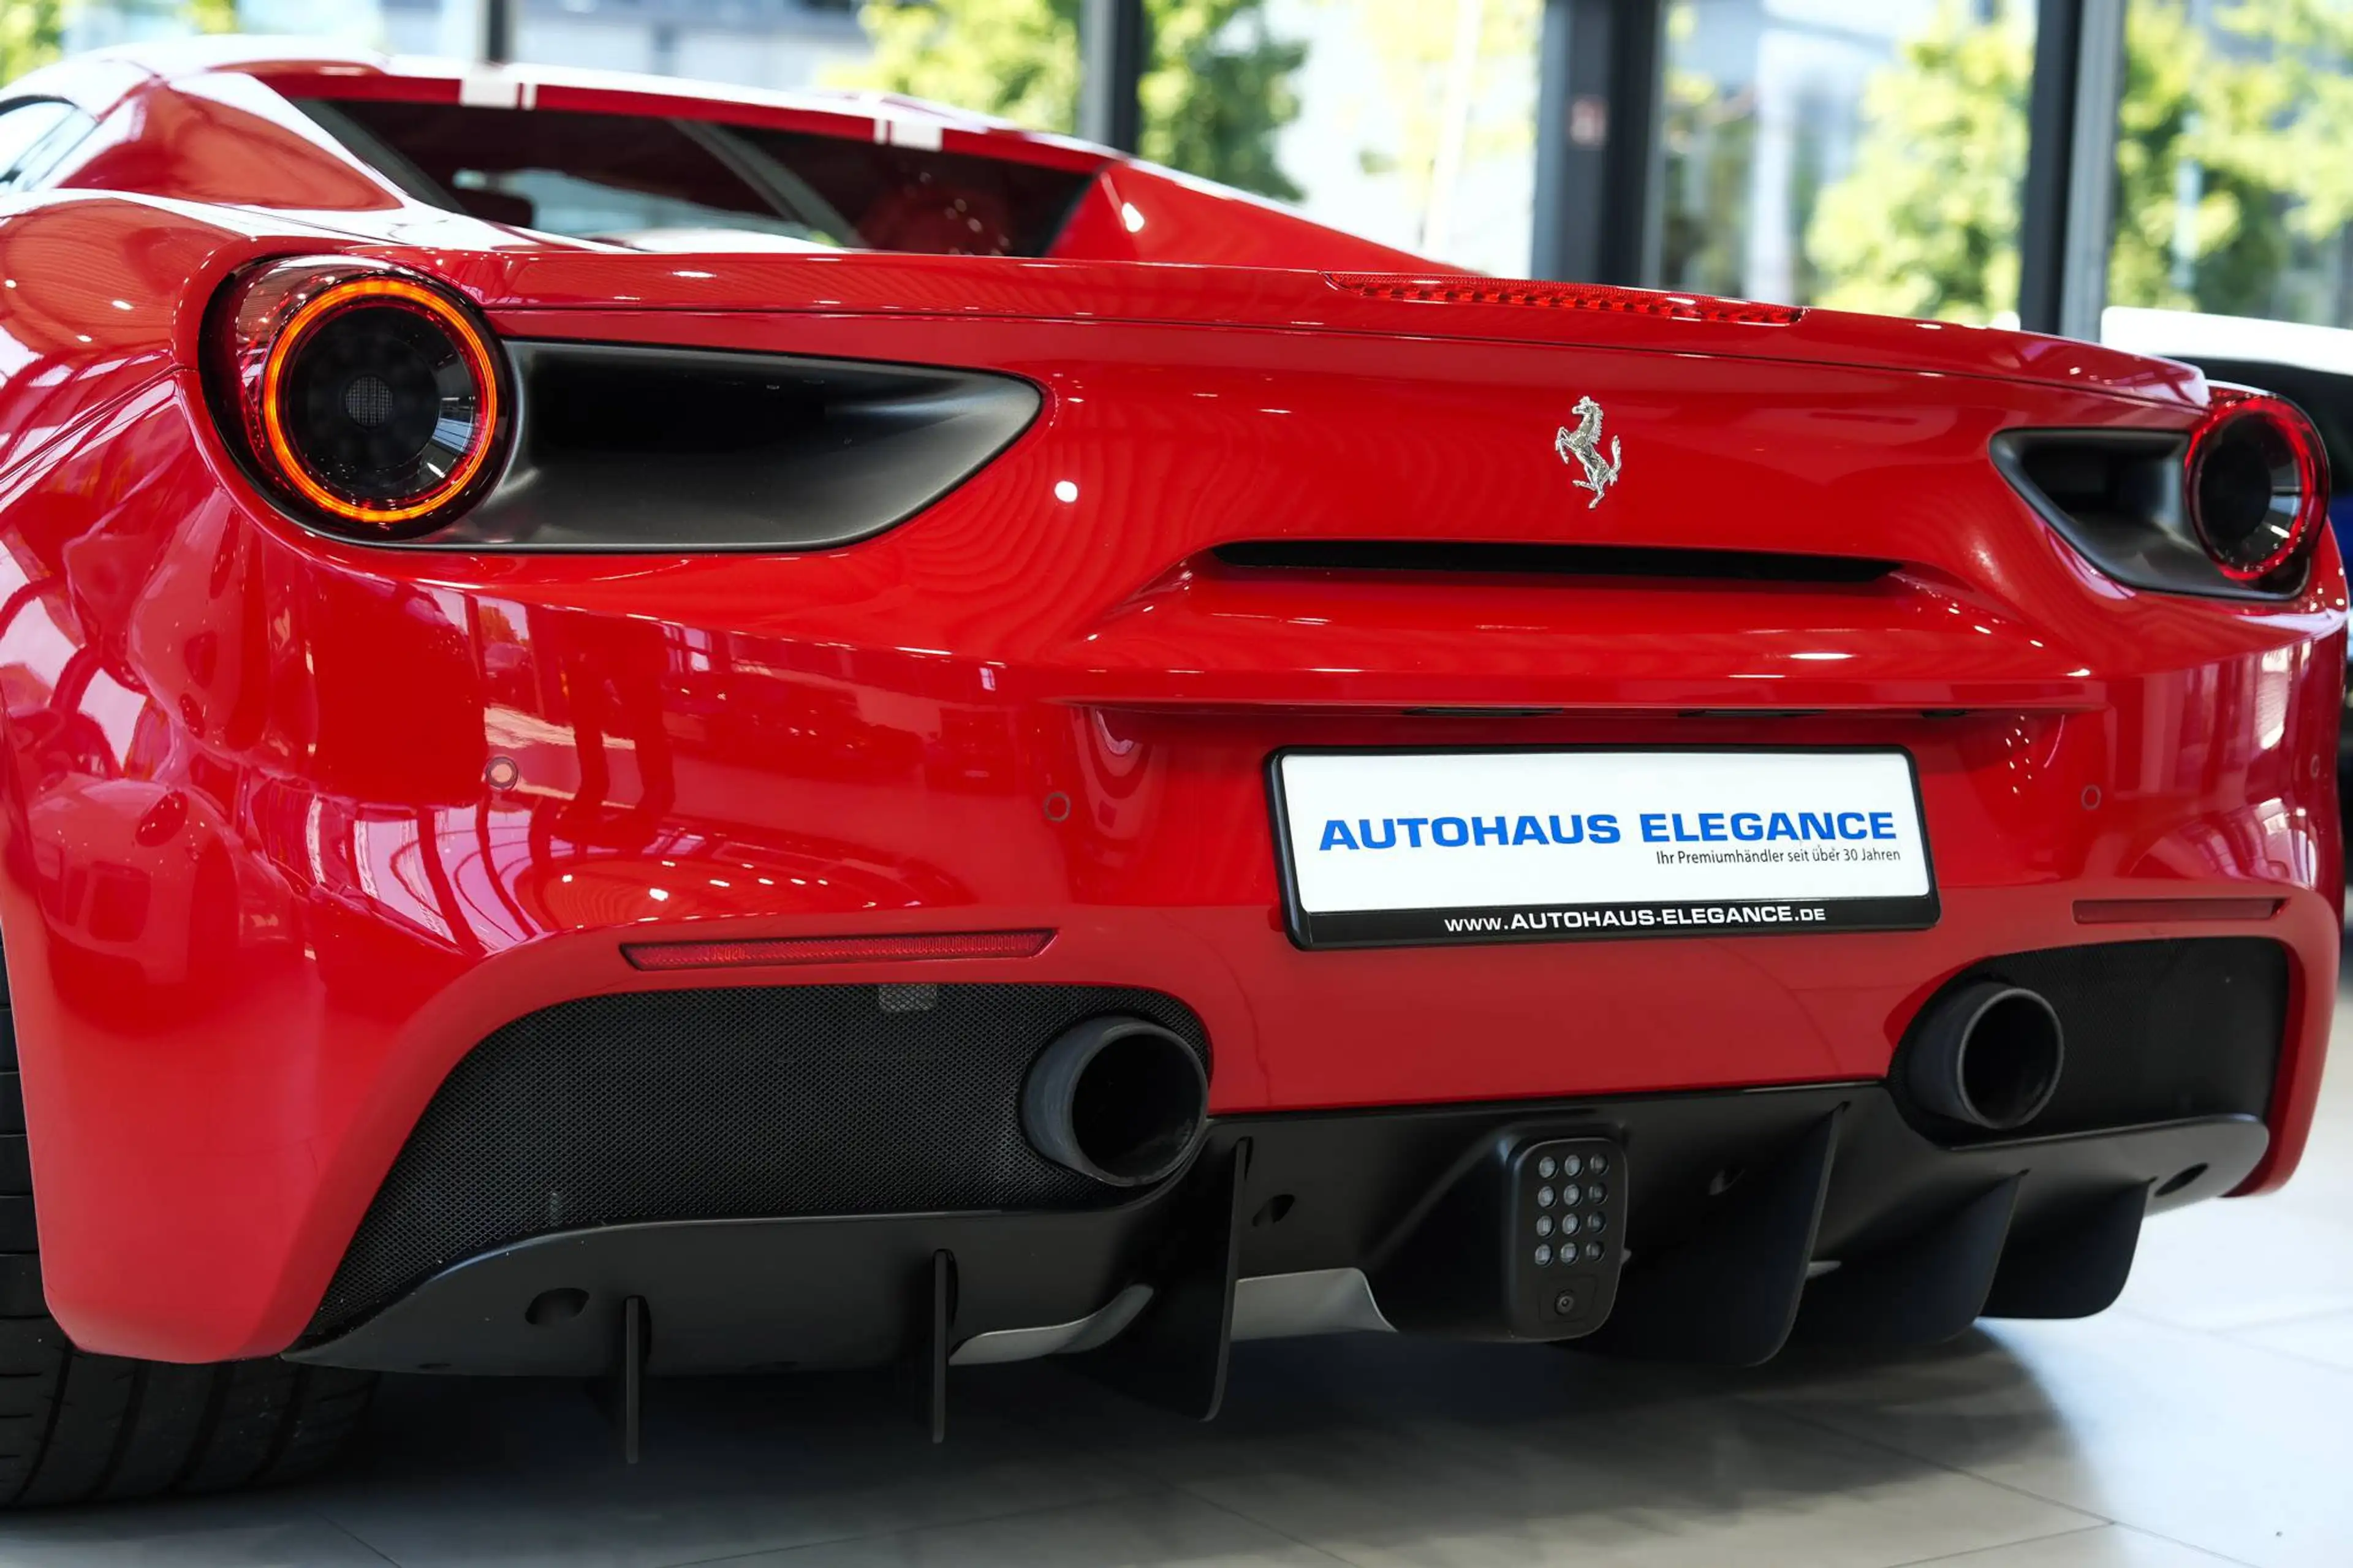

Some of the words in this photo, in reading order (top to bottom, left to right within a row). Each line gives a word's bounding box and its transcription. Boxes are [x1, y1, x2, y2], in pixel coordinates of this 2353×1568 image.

[1320, 814, 1621, 851] AUTOHAUS
[1640, 812, 1896, 842] ELEGANCE
[1656, 850, 1674, 865] Ihr
[1678, 849, 1784, 864] Premiumhändler
[1787, 848, 1809, 862] seit
[1812, 846, 1840, 862] über
[1843, 848, 1858, 861] 30
[1861, 847, 1901, 862] Jahren
